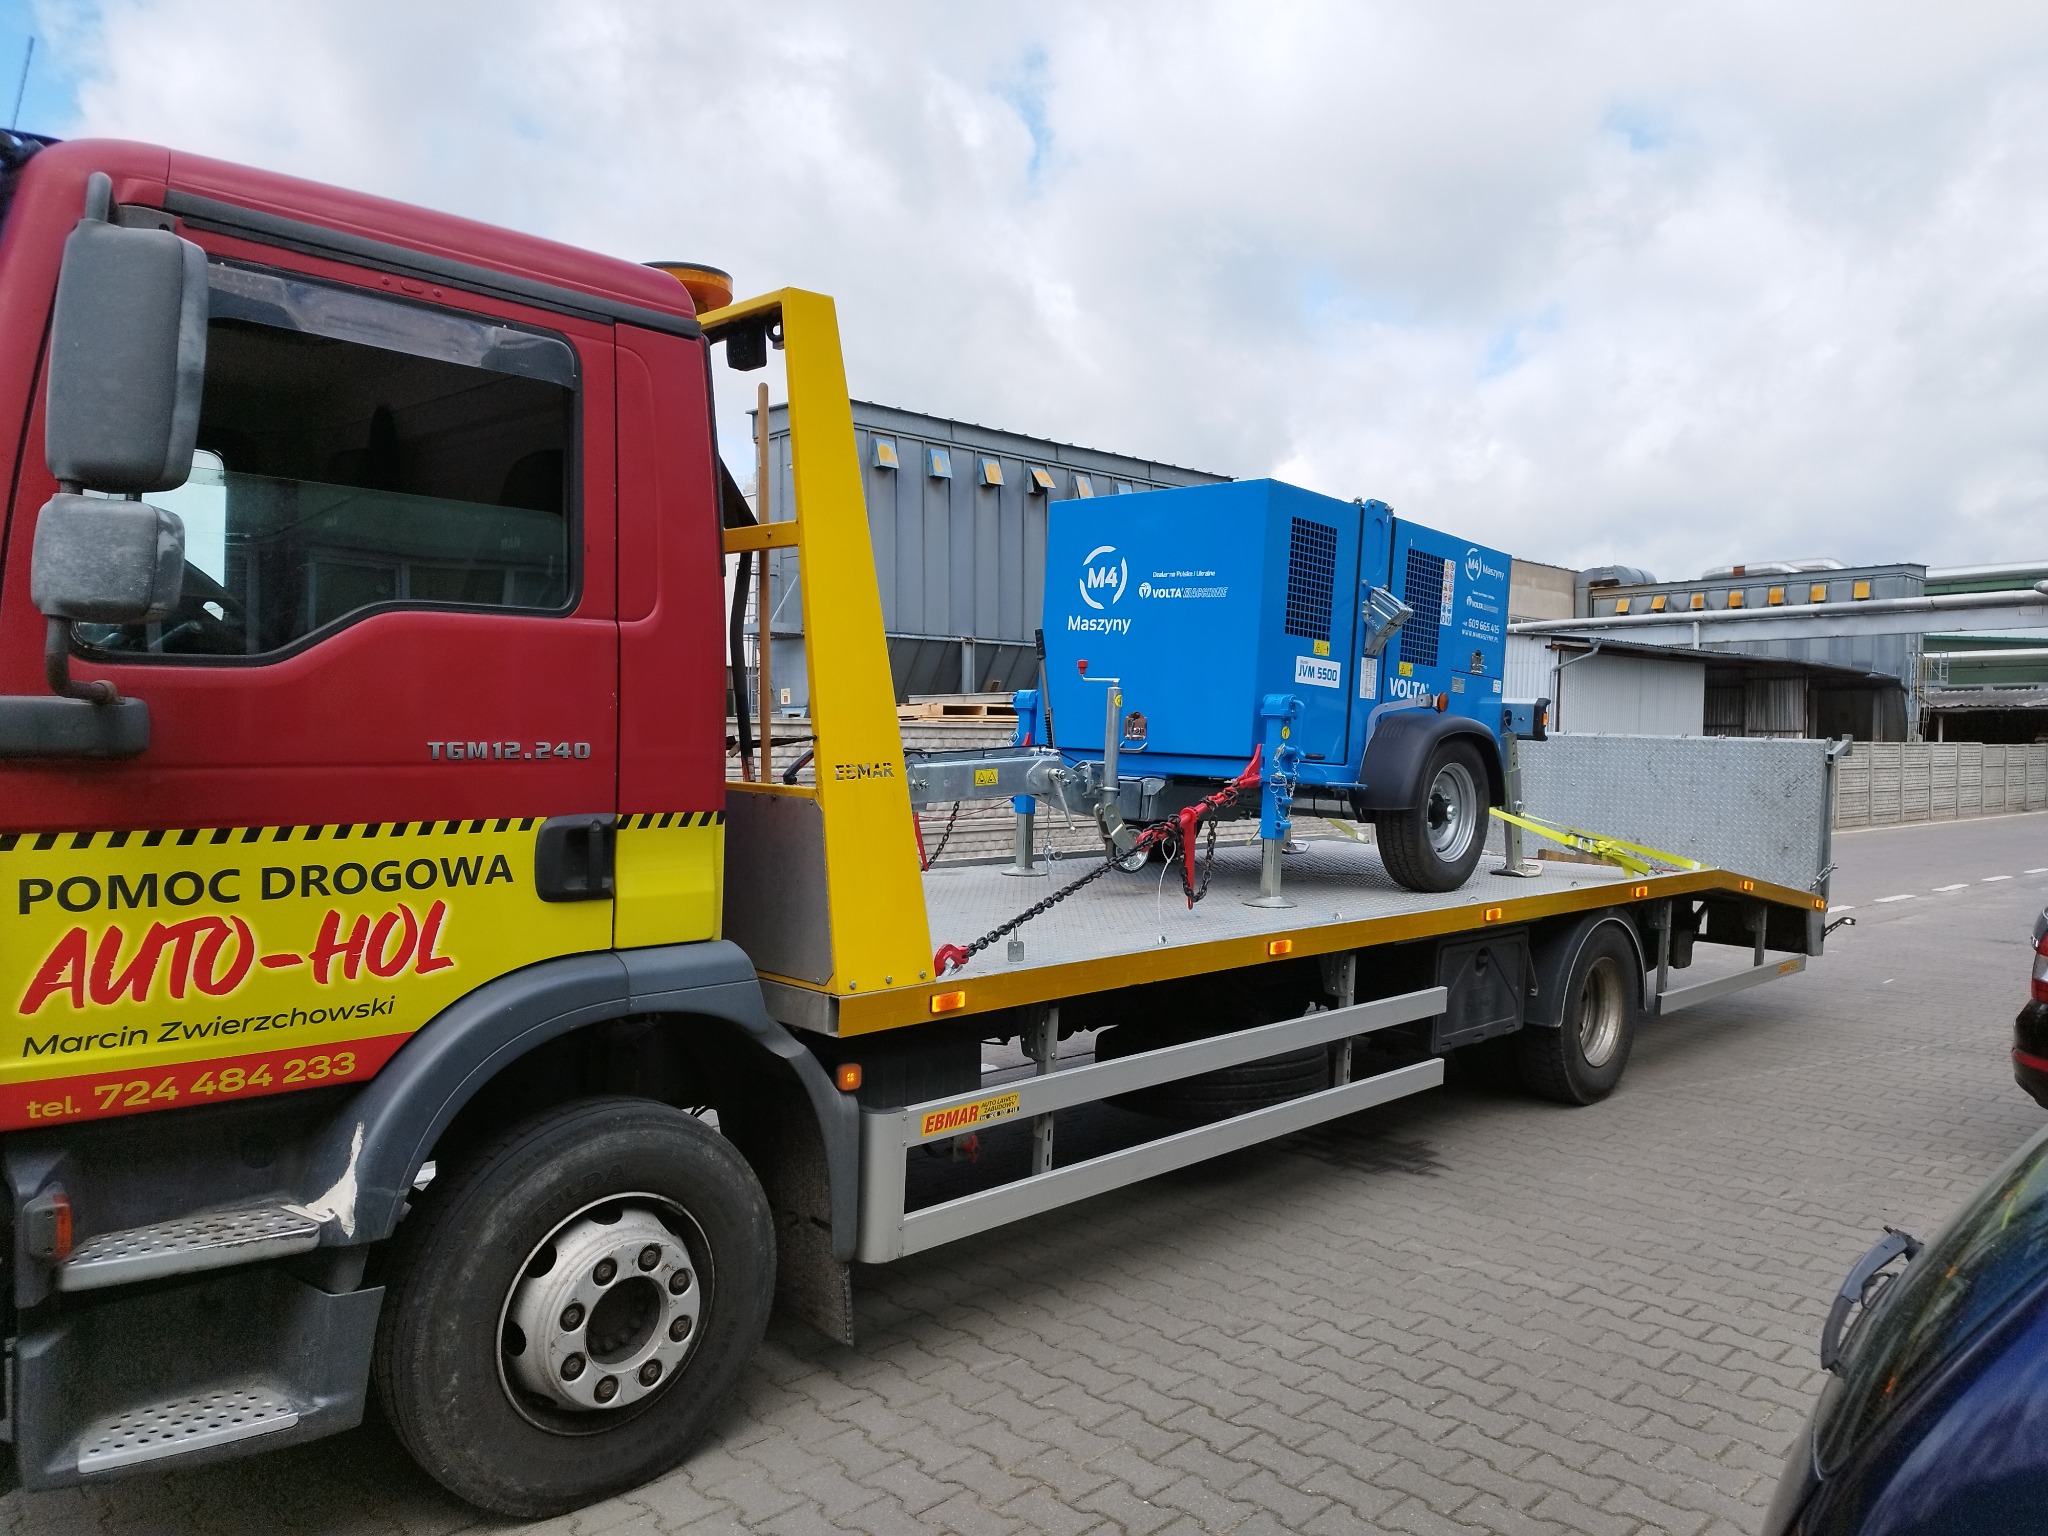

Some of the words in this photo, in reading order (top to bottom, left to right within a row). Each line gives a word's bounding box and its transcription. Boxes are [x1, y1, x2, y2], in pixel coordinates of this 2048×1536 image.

[1468, 557, 1479, 571] M4
[1482, 564, 1504, 581] Maszyny
[1087, 566, 1119, 589] M4
[1152, 587, 1182, 599] VOLTA
[1067, 615, 1132, 636] Maszyny
[1468, 617, 1479, 629] 609
[1298, 664, 1315, 679] JVM
[1317, 666, 1338, 682] 5500
[1389, 677, 1426, 700] VOLTA
[835, 762, 895, 781] EBMAR
[19, 869, 241, 914] POMOC
[261, 854, 515, 900] DROGOWA
[18, 900, 455, 1015] AUTO-HOL
[22, 1024, 149, 1058] Marcin
[156, 995, 396, 1043] Zwierzchowski
[26, 1097, 81, 1120] tel.
[95, 1077, 180, 1110] 724
[189, 1064, 273, 1096] 484
[282, 1051, 356, 1084] 233
[981, 1099, 997, 1109] AUTO
[984, 1100, 1016, 1114] ZABUDOWY
[924, 1105, 980, 1134] EBMAR
